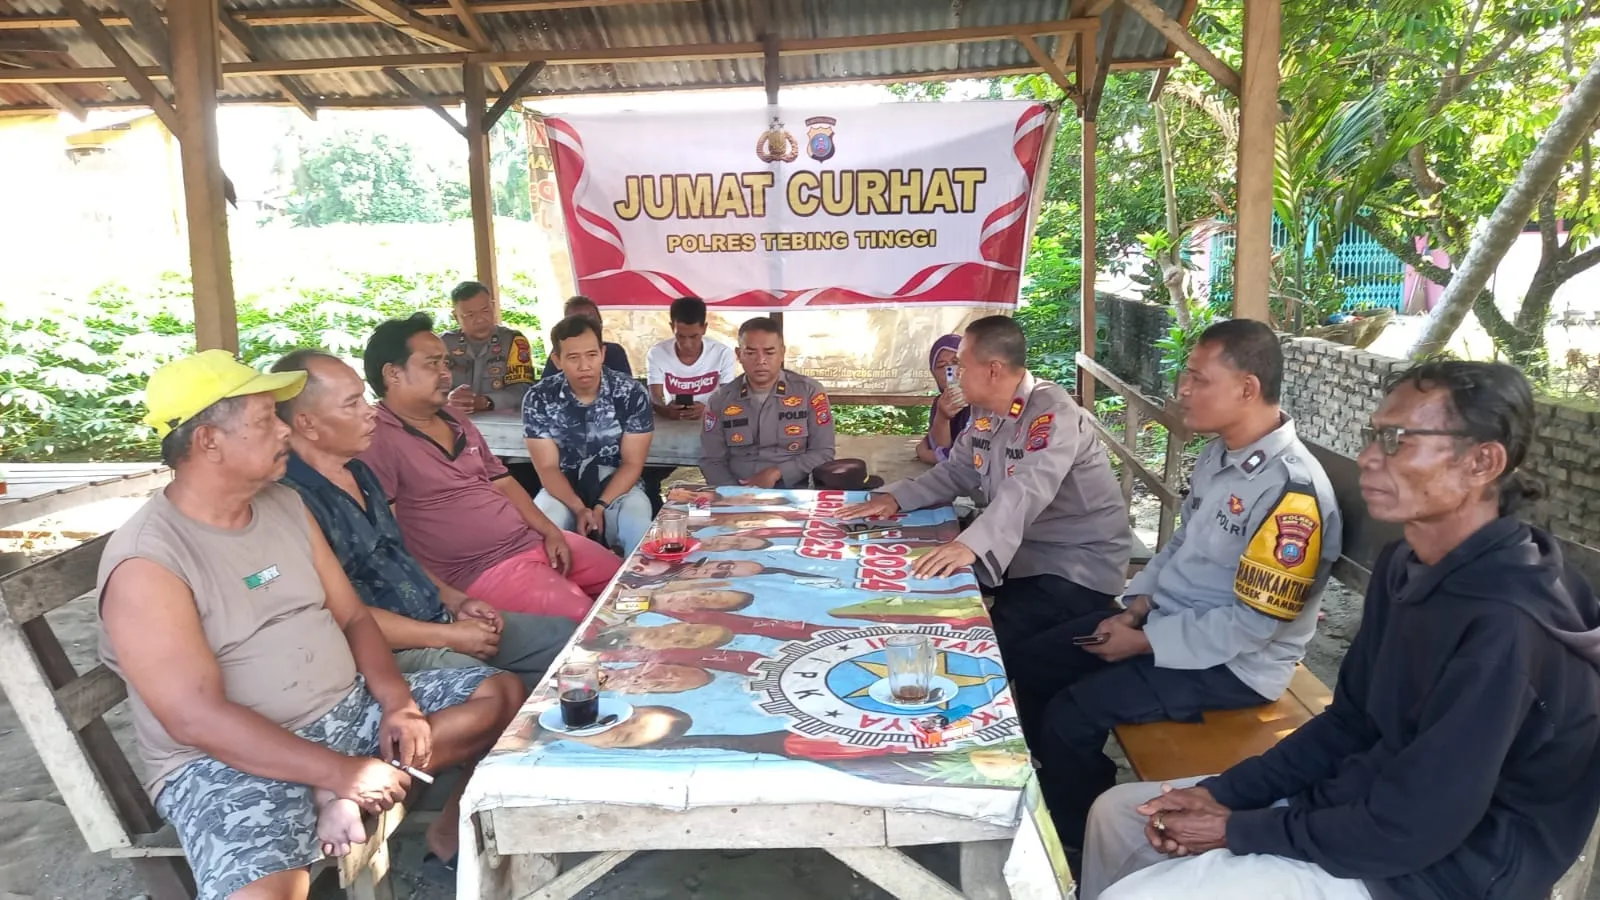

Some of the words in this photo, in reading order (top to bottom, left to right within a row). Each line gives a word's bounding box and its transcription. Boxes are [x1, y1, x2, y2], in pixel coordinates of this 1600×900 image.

[614, 171, 774, 221] JUMAT
[786, 168, 986, 217] CURHAT
[667, 233, 756, 253] POLRES
[761, 231, 848, 251] TEBING
[854, 229, 937, 248] TINGGI
[668, 374, 715, 392] Wrangler
[799, 519, 847, 560] 2025
[1216, 509, 1247, 537] POLRI
[859, 543, 911, 592] 2024
